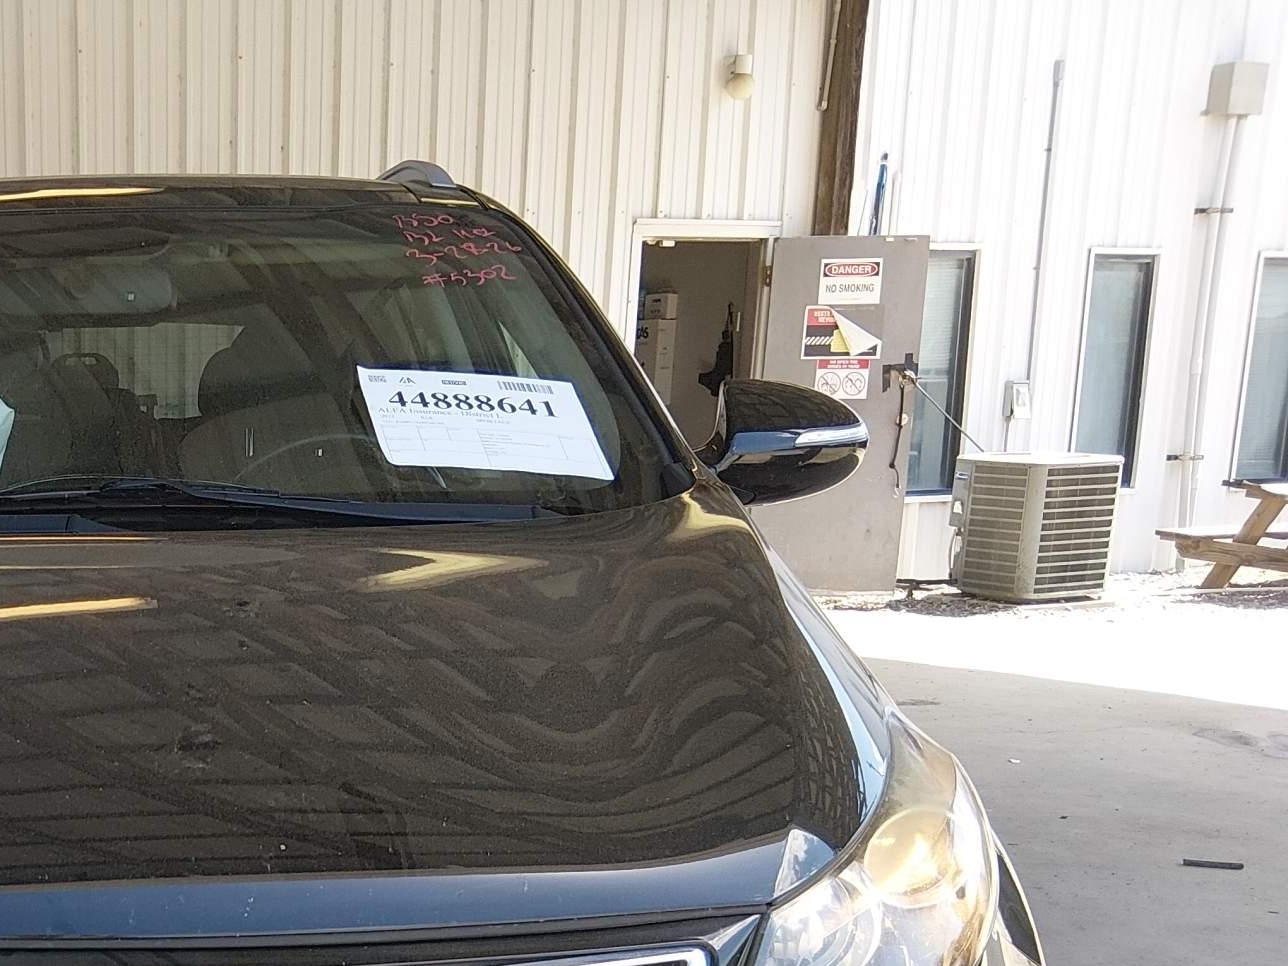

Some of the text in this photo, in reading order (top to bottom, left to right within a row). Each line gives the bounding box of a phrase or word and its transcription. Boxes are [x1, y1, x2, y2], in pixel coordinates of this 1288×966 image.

[831, 264, 872, 274] DANGER
[825, 283, 875, 293] NO SMOKING
[388, 390, 559, 418] 44888641
